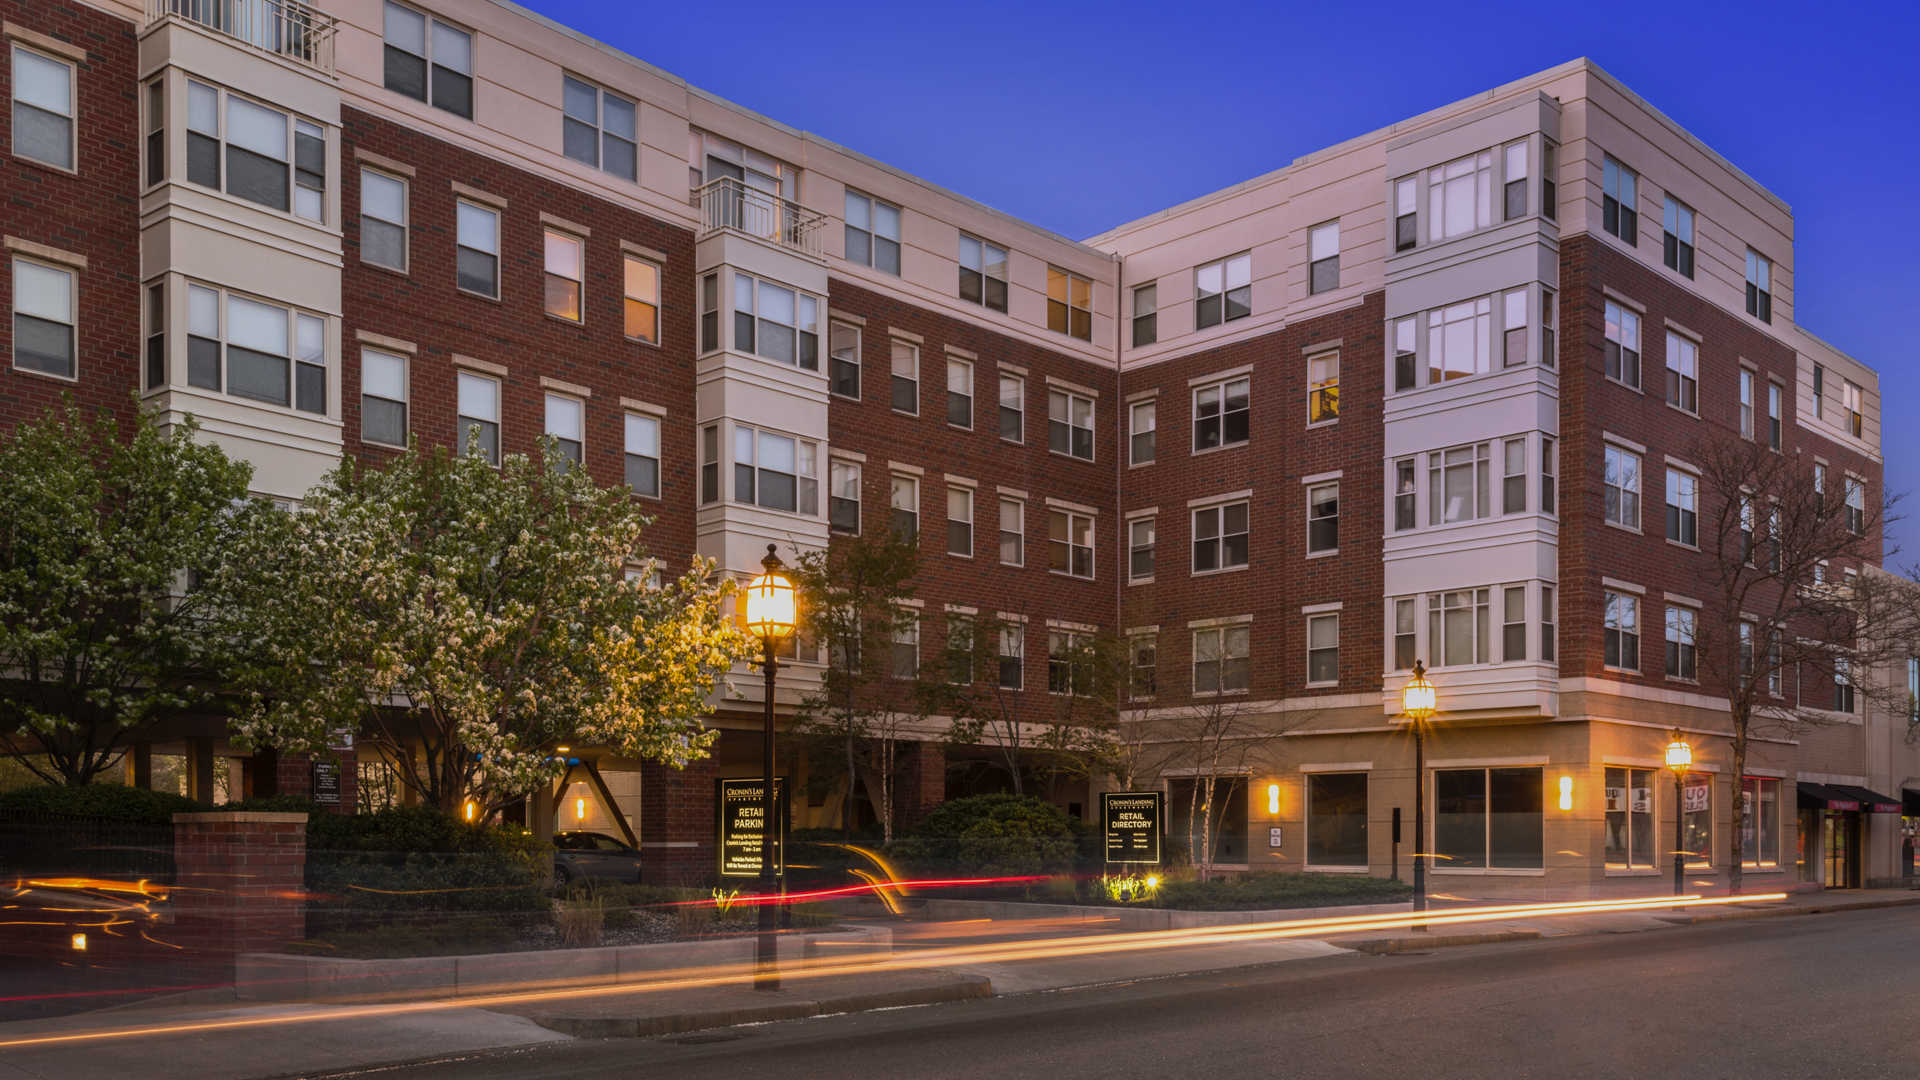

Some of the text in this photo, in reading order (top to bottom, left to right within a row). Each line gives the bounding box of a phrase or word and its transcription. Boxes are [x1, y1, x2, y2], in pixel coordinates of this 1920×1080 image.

[1119, 812, 1145, 820] RETAIL
[734, 819, 764, 829] PARKIN
[1111, 820, 1152, 829] DIRECTORY
